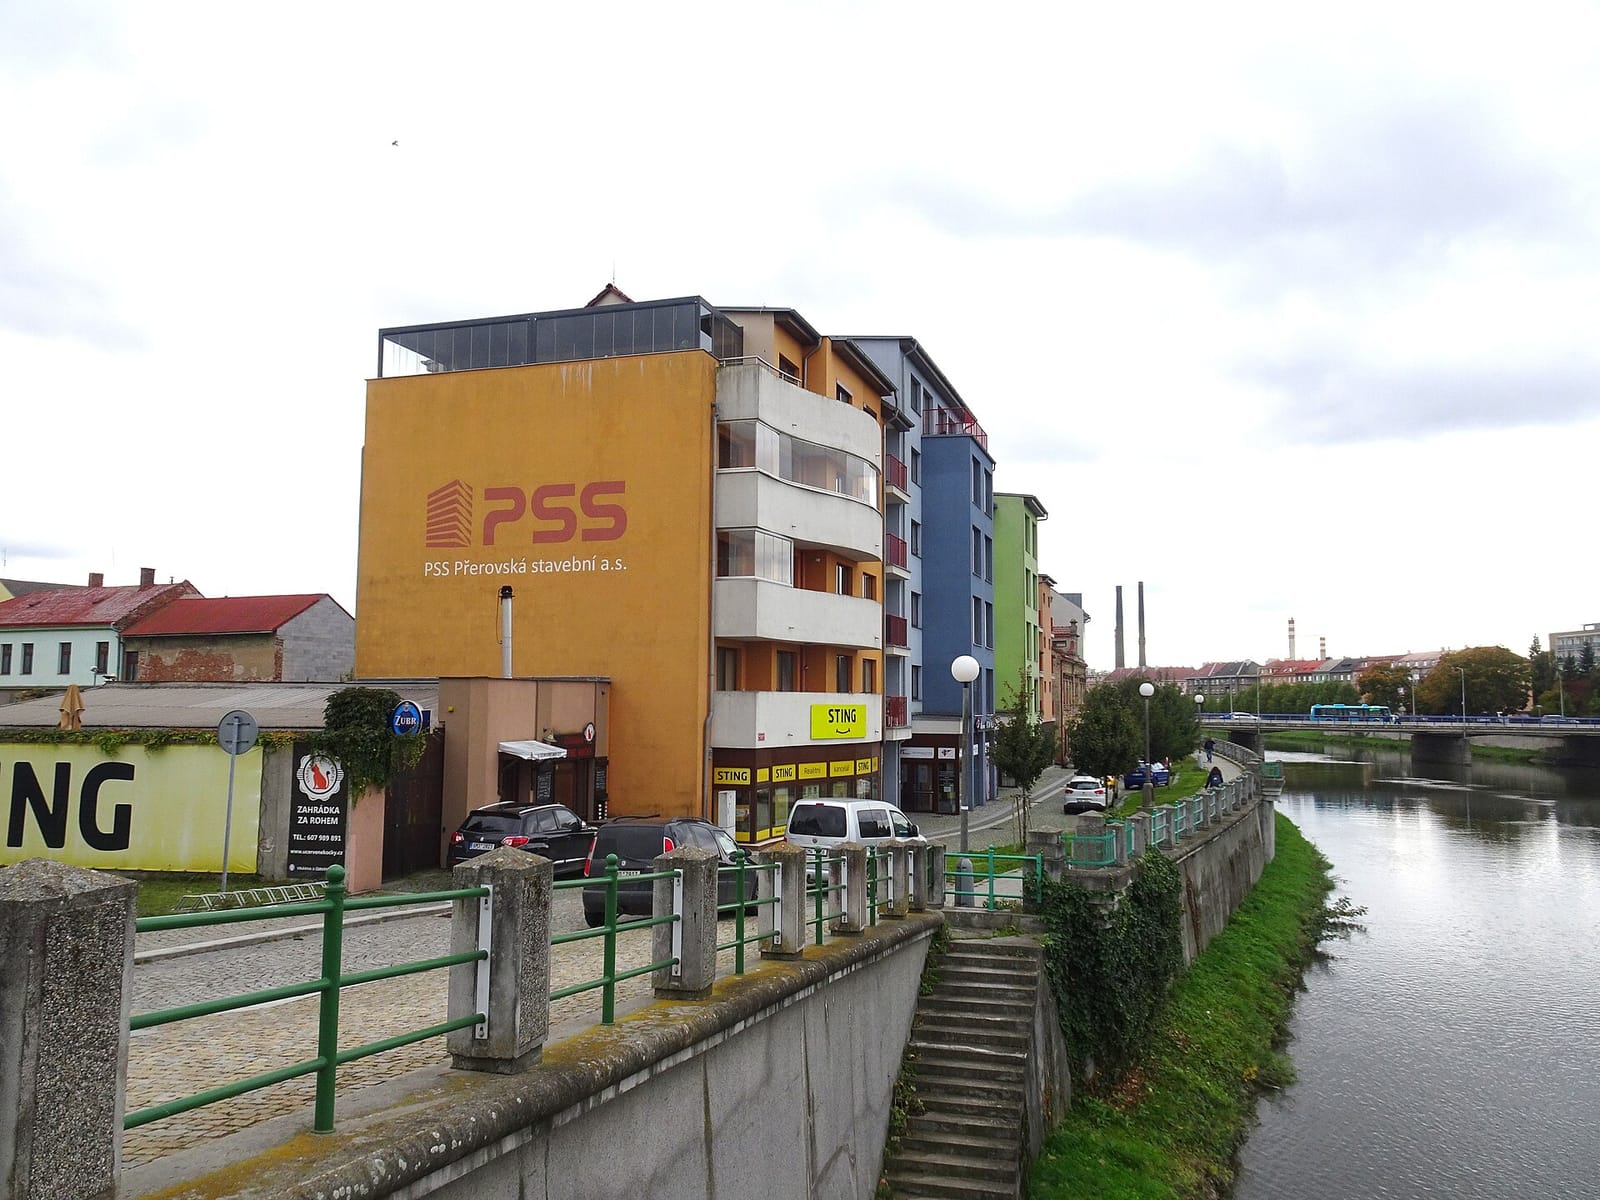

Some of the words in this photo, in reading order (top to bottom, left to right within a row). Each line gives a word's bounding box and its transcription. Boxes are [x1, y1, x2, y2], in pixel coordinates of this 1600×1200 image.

[483, 481, 628, 546] PSS
[424, 560, 450, 577] PSS
[454, 557, 526, 576] Přerovská
[531, 555, 597, 573] stavební
[600, 557, 627, 571] a.s.
[394, 715, 417, 726] ZUBR
[828, 708, 856, 724] STING
[857, 761, 869, 772] STING
[717, 770, 748, 782] STING
[775, 767, 793, 779] STING
[0, 761, 135, 851] NG
[296, 804, 340, 815] ZAHRÁDKA
[297, 816, 308, 825] ZA
[309, 816, 339, 825] ROHEM
[293, 833, 306, 841] TEL.:
